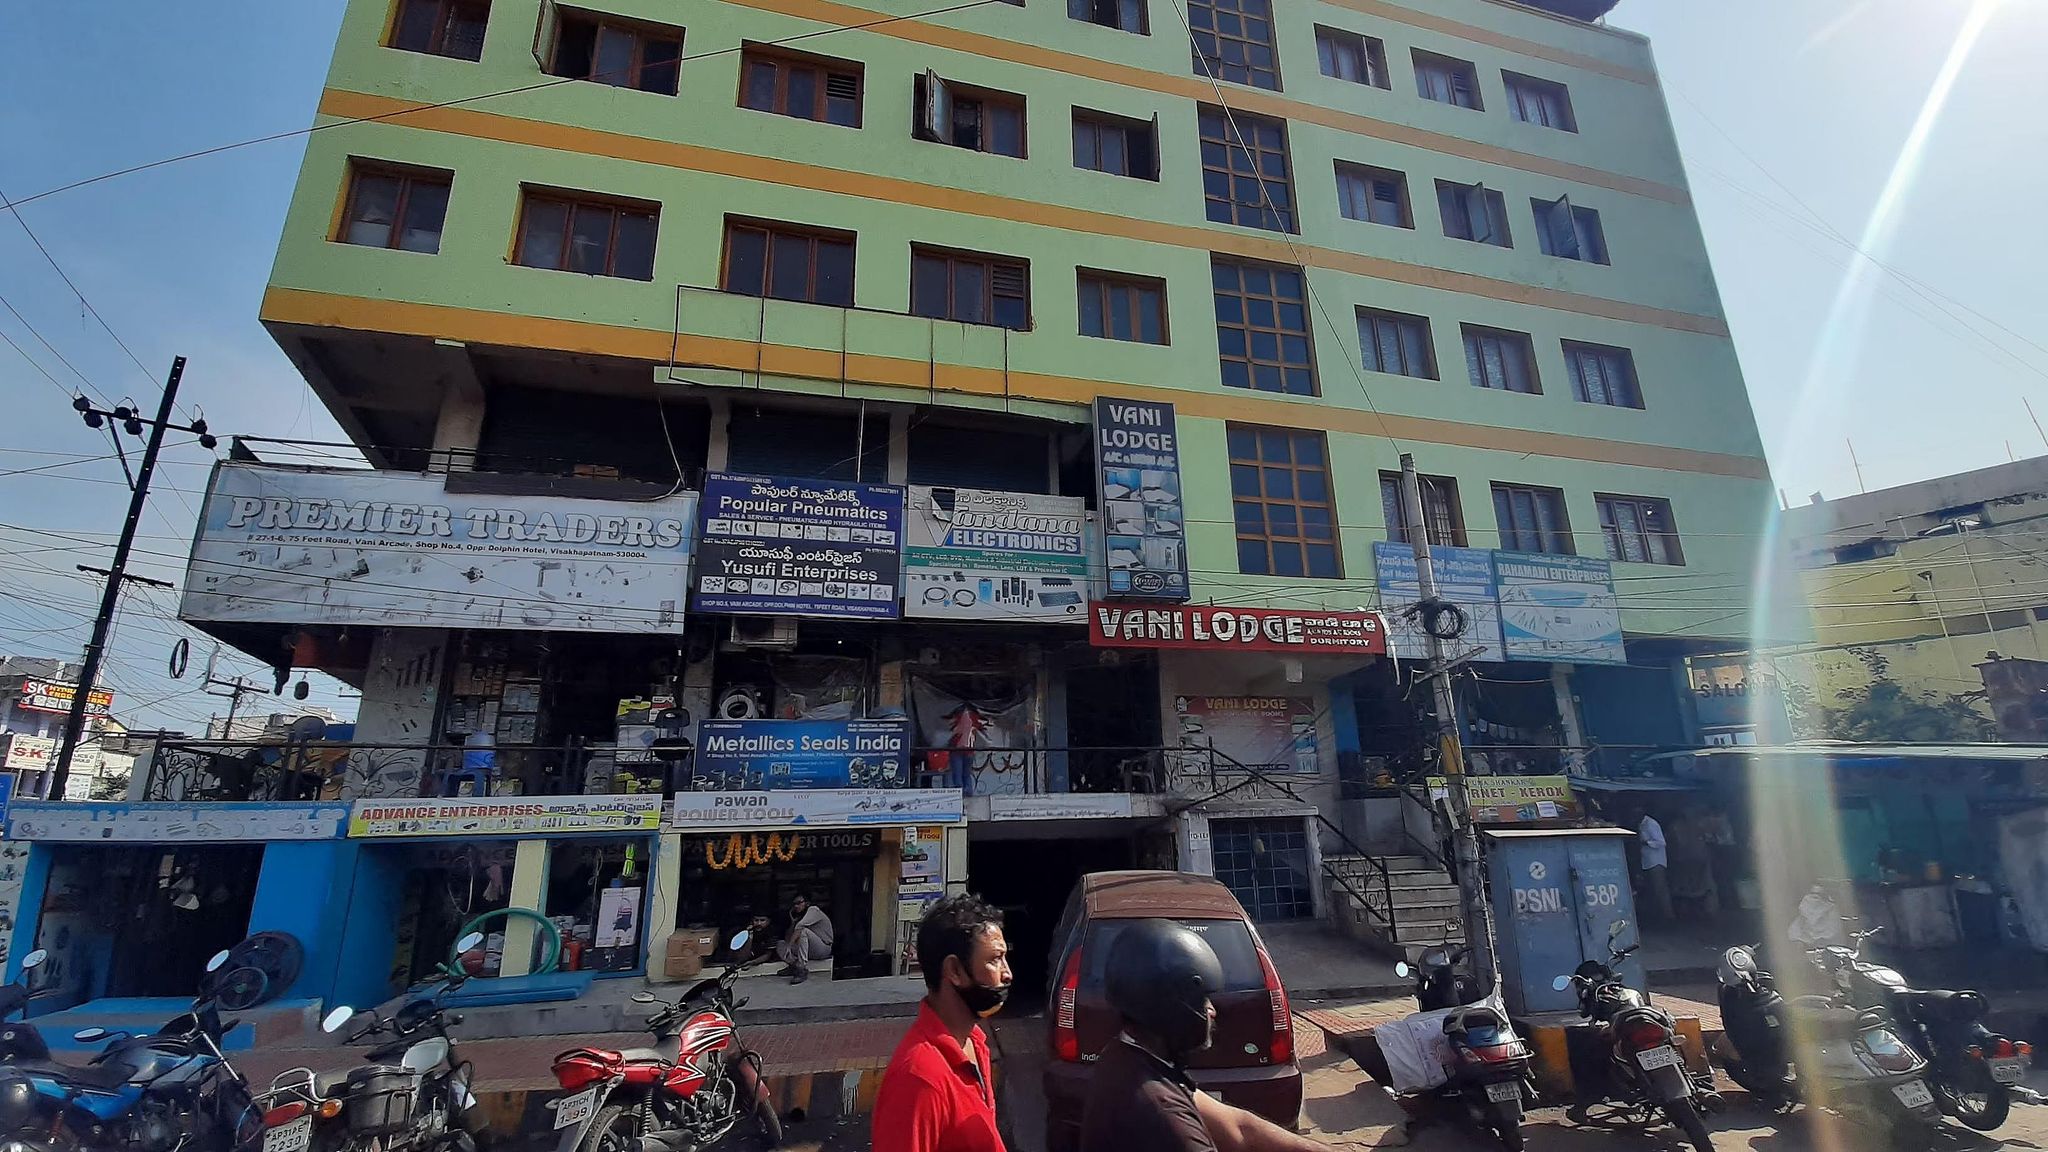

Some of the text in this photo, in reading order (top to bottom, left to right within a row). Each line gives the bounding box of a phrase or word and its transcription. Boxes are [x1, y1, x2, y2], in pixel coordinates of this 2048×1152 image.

[1108, 404, 1161, 426] VANI
[1102, 428, 1174, 451] LODGE
[720, 496, 888, 521] Popular Pneumatics
[227, 496, 682, 549] PREMIER TRADERS
[779, 516, 818, 524] PNEUMATICS
[914, 502, 1081, 547] Vandana
[325, 537, 352, 545] Road,
[355, 538, 376, 546] Vani
[415, 541, 438, 550] Shop
[441, 543, 464, 551] No.4,
[488, 545, 520, 553] Dolphin
[953, 530, 1078, 552] ELECTRONICS
[721, 559, 878, 582] Yusufi Enterprises
[1497, 563, 1549, 579] RAHAMANI
[1550, 565, 1610, 582] ENTERPRISES
[1098, 607, 1304, 644] VANI LODGE
[1310, 638, 1369, 647] DORMITORY
[27, 680, 49, 695] SK
[1205, 698, 1288, 709] VANI LODGE
[706, 735, 901, 752] Metallics Seals India
[1519, 786, 1564, 798] XEROX
[361, 806, 436, 820] ADVANCE
[440, 804, 543, 818] ENTERPRISES
[678, 808, 738, 821] POWER
[820, 833, 872, 848] TOOLS
[1585, 884, 1619, 906] 58P
